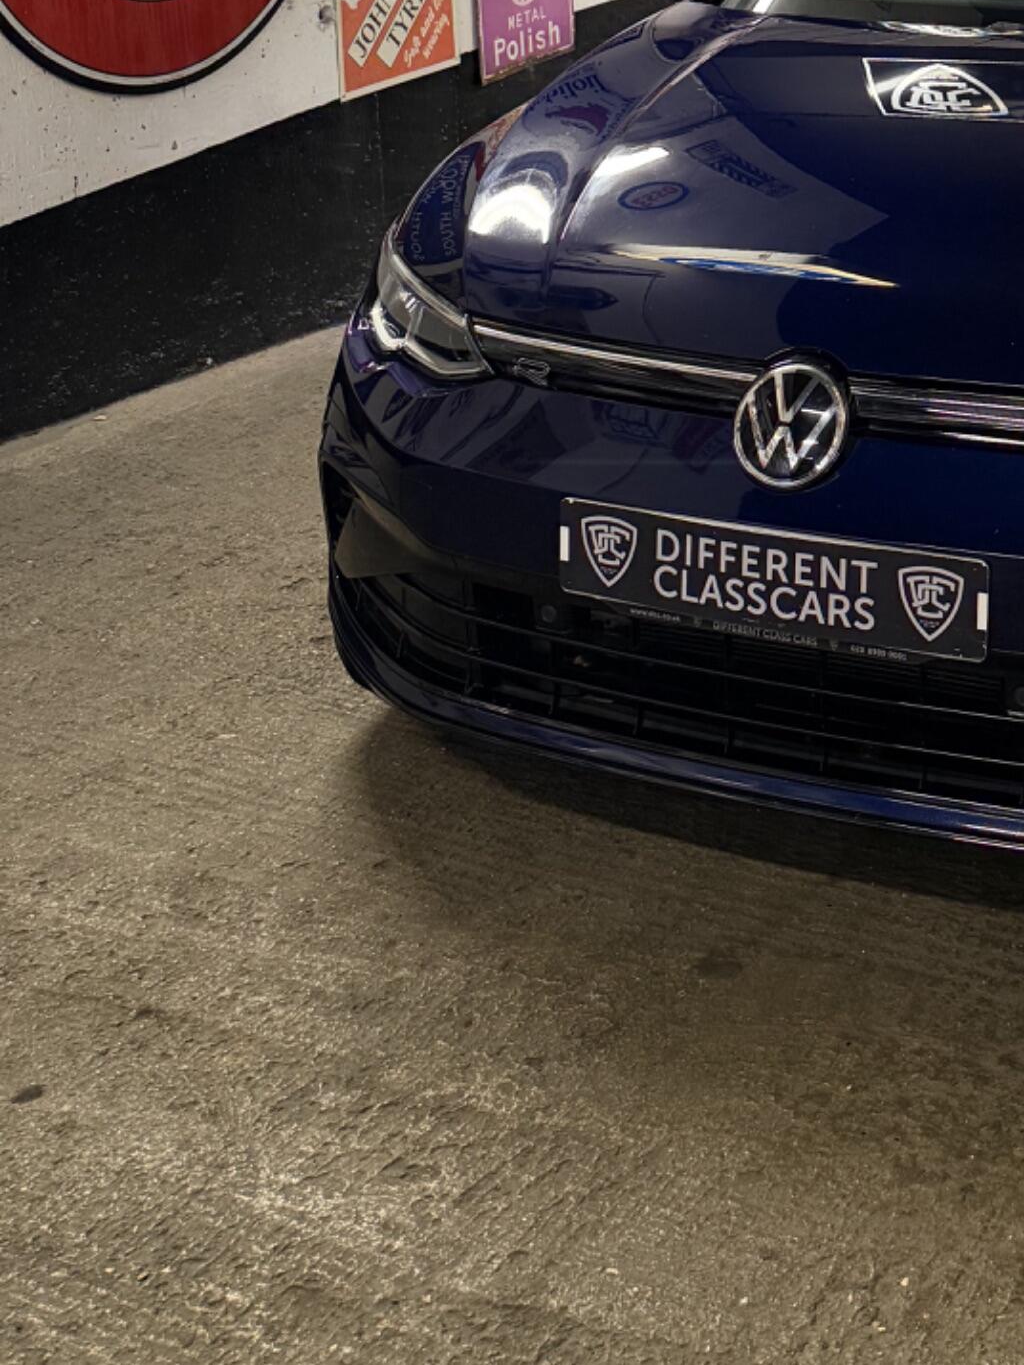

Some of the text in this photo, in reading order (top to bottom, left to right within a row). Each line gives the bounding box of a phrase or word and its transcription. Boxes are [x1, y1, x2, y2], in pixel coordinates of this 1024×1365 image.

[419, 6, 435, 38] and
[507, 7, 547, 30] METAL
[494, 21, 561, 67] Polish
[655, 528, 879, 594] DIFFERENT
[653, 564, 876, 631] CLASSCARS
